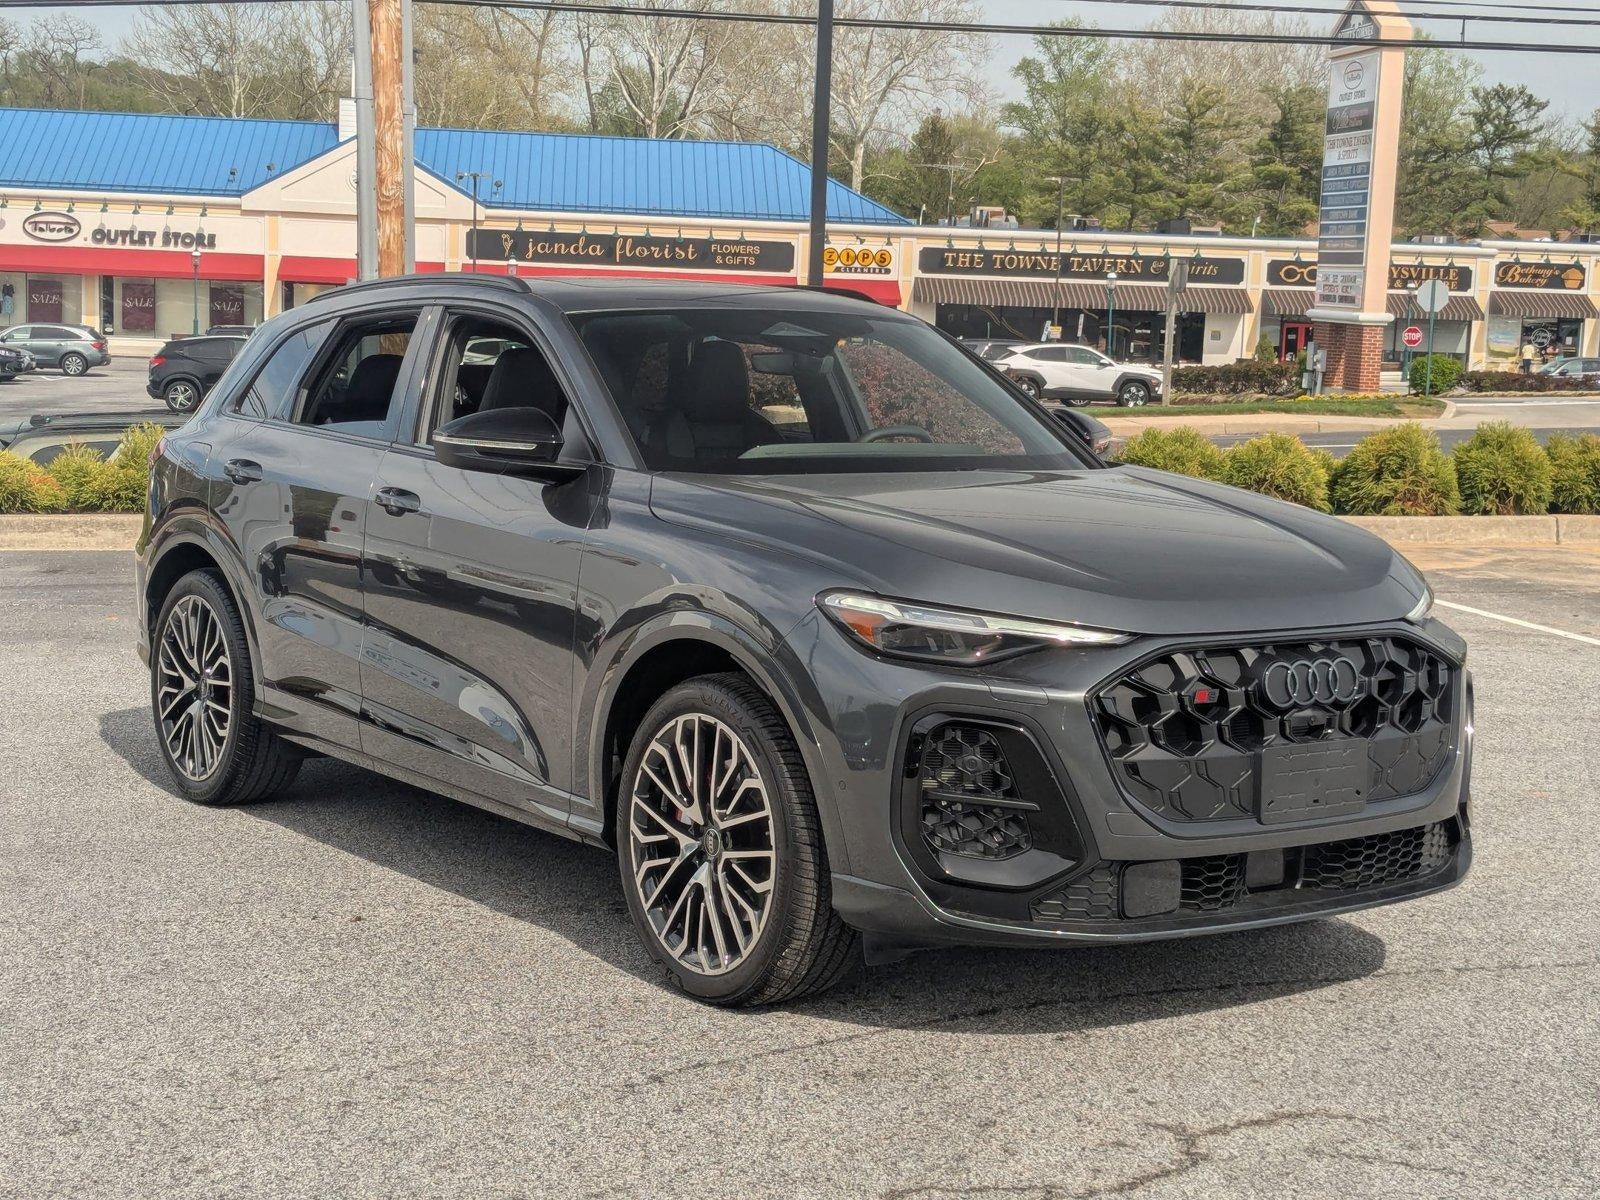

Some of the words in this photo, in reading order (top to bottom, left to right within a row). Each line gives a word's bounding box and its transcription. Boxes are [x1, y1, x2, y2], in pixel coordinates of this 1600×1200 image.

[92, 228, 156, 246] OUTLET
[162, 231, 216, 248] STORE
[525, 237, 605, 259] janda
[615, 239, 698, 262] florist
[711, 244, 760, 255] FLOWERS
[715, 256, 724, 265] &
[725, 256, 756, 265] GIFTS
[825, 249, 888, 265] ZIPS
[944, 252, 985, 268] THE
[992, 254, 1061, 272] TOWNE
[1070, 257, 1144, 274] TAVERN
[1150, 260, 1165, 274] &
[1390, 266, 1459, 280] YSVILLE
[31, 293, 60, 305] SALE
[125, 297, 153, 308] SALE
[213, 301, 242, 312] SALE
[1404, 333, 1421, 341] STOP
